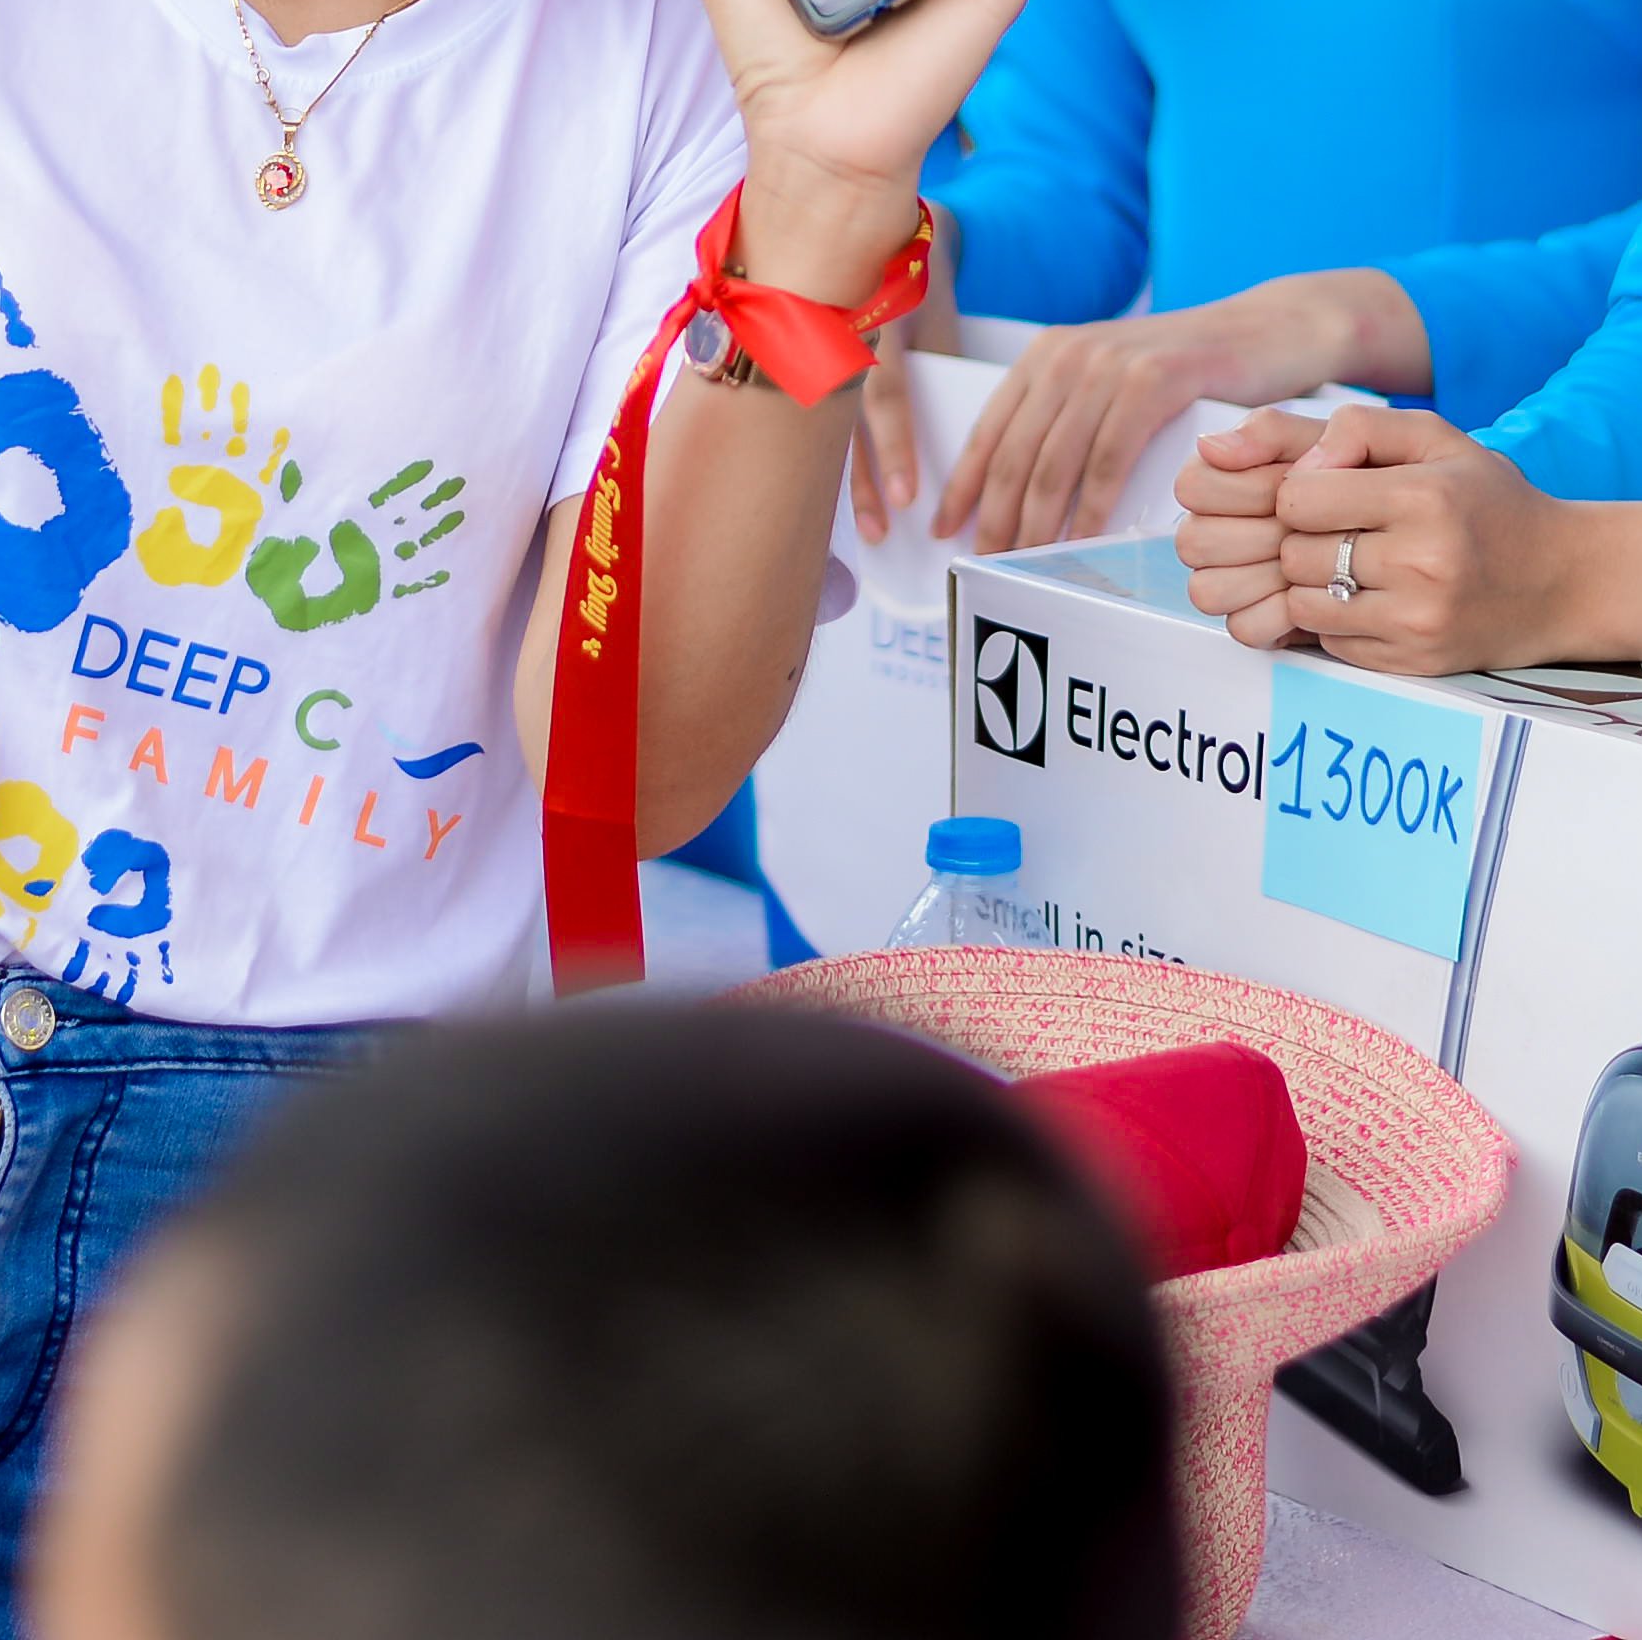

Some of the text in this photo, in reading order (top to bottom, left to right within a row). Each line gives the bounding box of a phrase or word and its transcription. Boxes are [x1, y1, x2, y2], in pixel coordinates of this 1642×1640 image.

[71, 614, 354, 752] DEEP C
[1065, 676, 1267, 802] Electrol
[61, 703, 462, 861] FAMILY
[1270, 719, 1464, 846] 1300K
